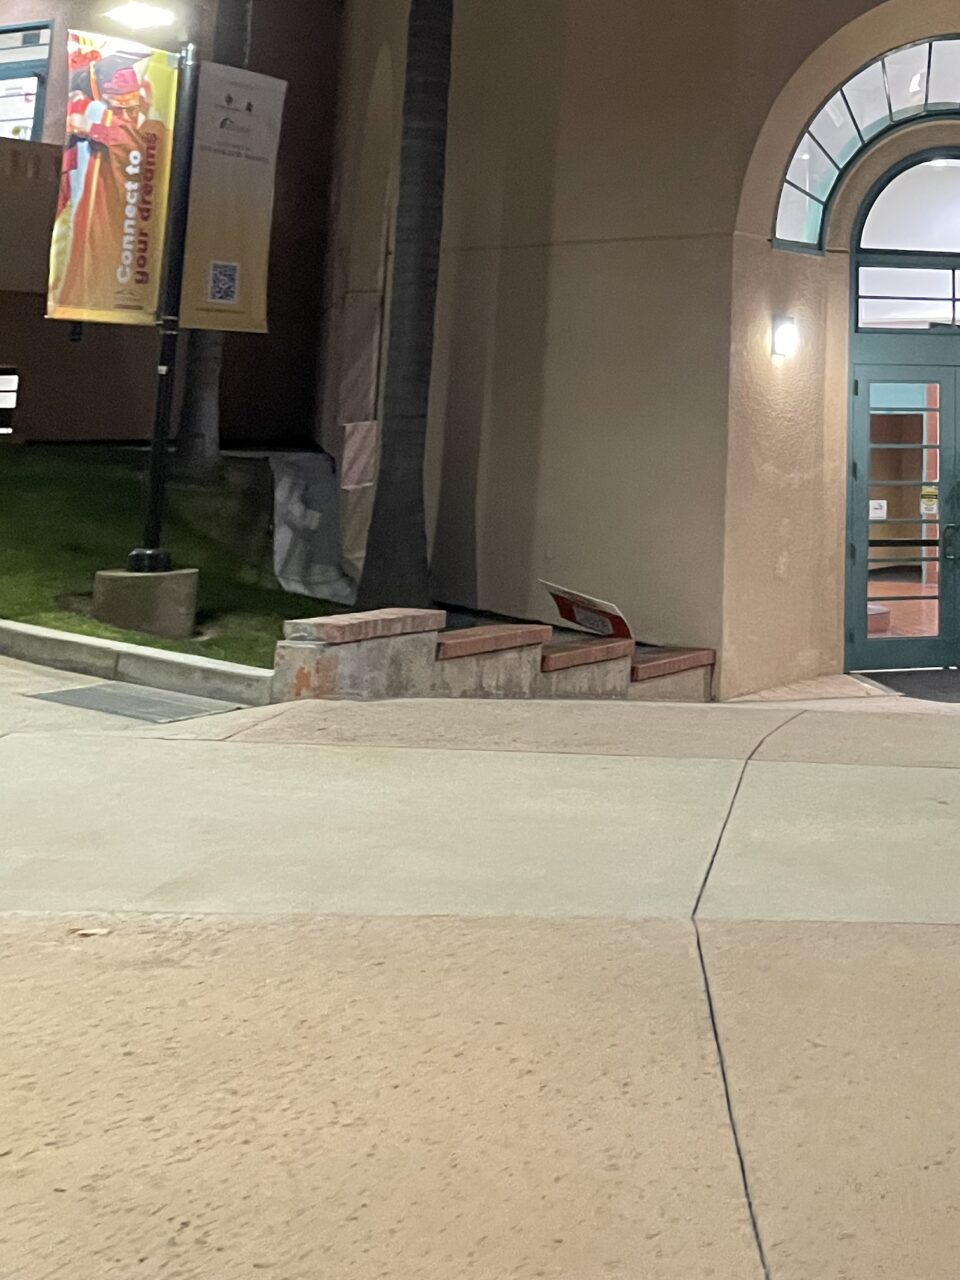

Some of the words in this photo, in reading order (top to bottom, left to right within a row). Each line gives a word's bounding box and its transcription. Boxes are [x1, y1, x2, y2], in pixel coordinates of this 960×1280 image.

[125, 149, 142, 175] to
[138, 133, 157, 222] dreams
[117, 180, 139, 284] Connect
[135, 231, 149, 285] your
